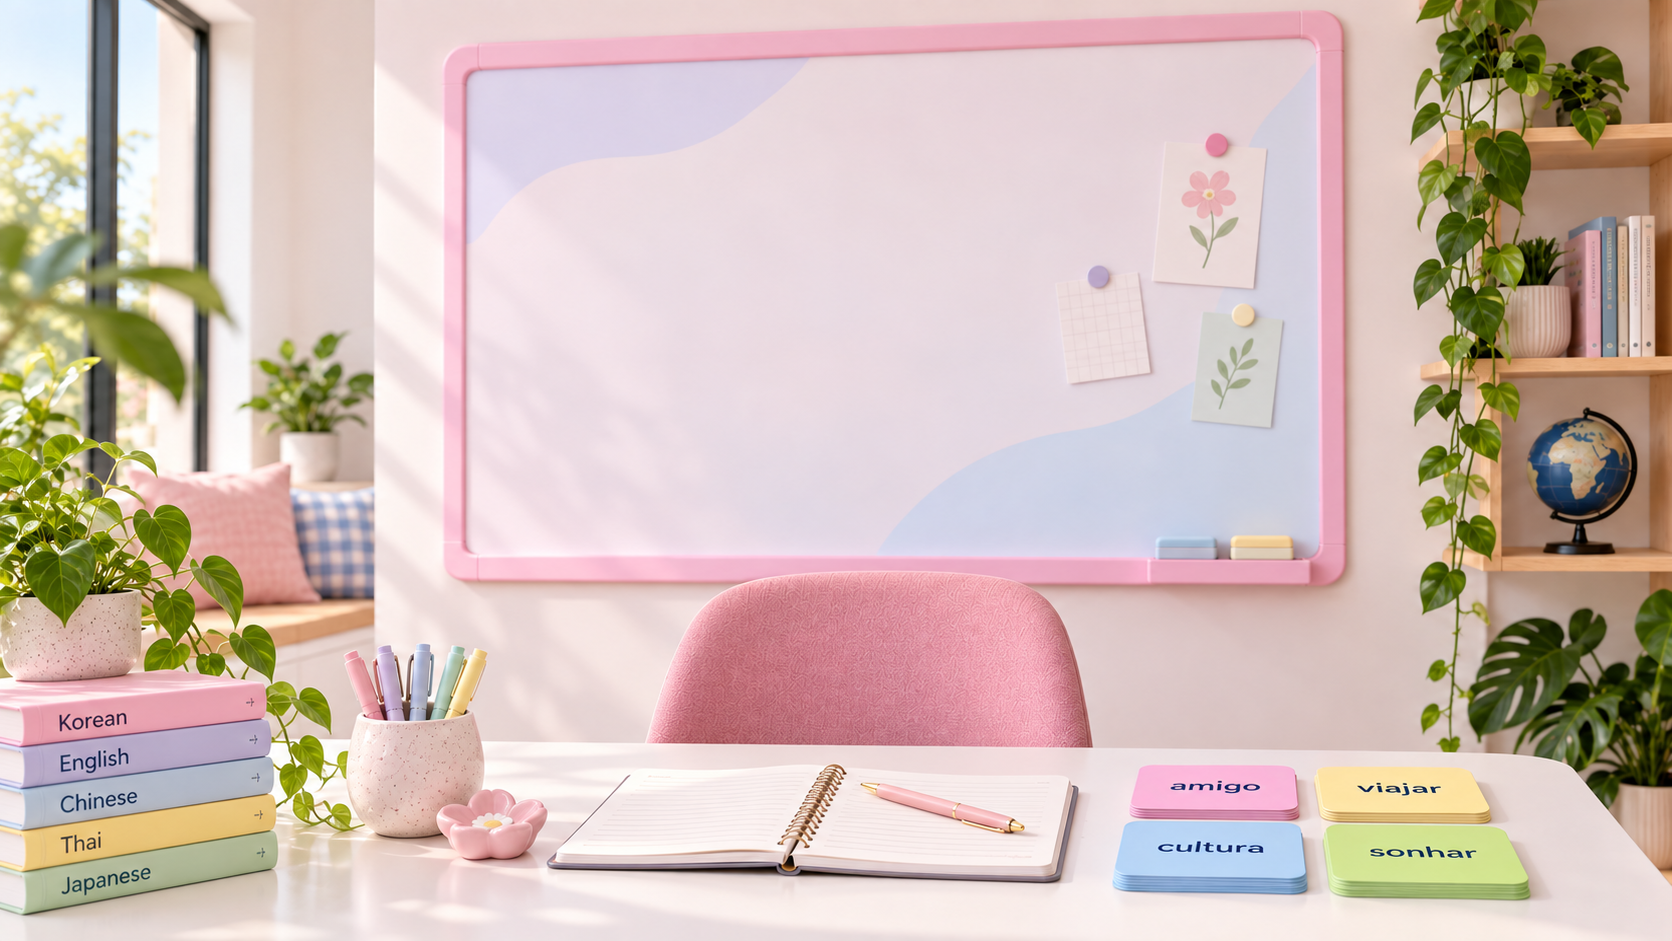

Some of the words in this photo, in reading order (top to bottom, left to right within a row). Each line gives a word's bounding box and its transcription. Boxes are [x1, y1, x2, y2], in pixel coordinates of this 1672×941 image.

[58, 711, 128, 732] Korean
[60, 748, 129, 775] English
[1170, 779, 1261, 795] amigo
[1357, 782, 1442, 797] viajar
[60, 791, 138, 813] Chinese
[60, 831, 103, 854] Thai
[1157, 840, 1264, 854] cultura
[1369, 845, 1477, 860] sonhar
[61, 867, 151, 896] Japanese
